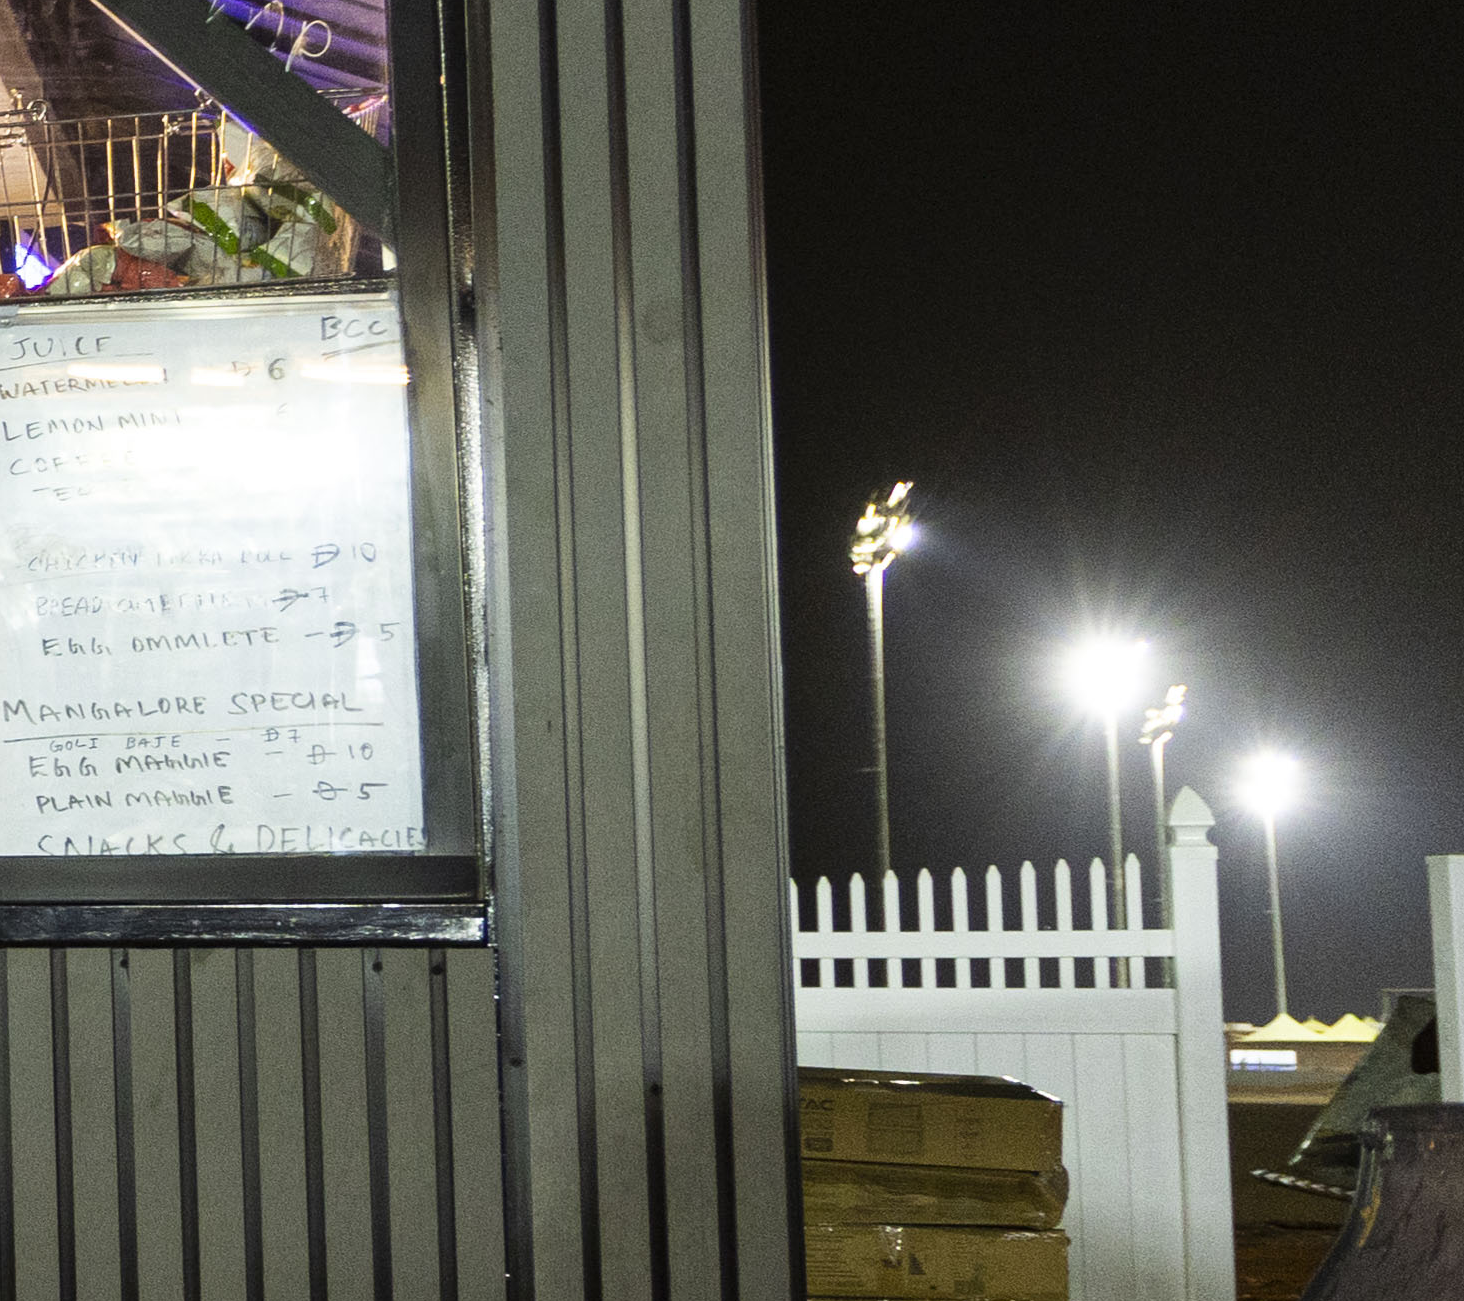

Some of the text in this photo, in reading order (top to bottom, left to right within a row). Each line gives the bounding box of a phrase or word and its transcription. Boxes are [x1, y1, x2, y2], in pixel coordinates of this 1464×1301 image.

[321, 316, 388, 340] BCC
[0, 368, 167, 400] WATERME
[268, 358, 287, 380] 6
[2, 414, 103, 442] LEMON
[9, 450, 135, 476] COFFE
[352, 542, 377, 562] 10
[42, 637, 112, 656] EGG
[379, 622, 401, 642] 5
[3, 692, 363, 726] MANGALORE SPECIAL
[49, 737, 99, 752] GOLI
[125, 734, 182, 749] BAJE
[287, 729, 301, 743] 7
[29, 756, 98, 778] EGG
[115, 752, 231, 774] MAGGIE
[348, 742, 373, 761] 10
[36, 790, 112, 814] PLAIN
[125, 786, 233, 807] MAGGIE
[357, 783, 388, 800] 5
[38, 834, 187, 856] SNACKS
